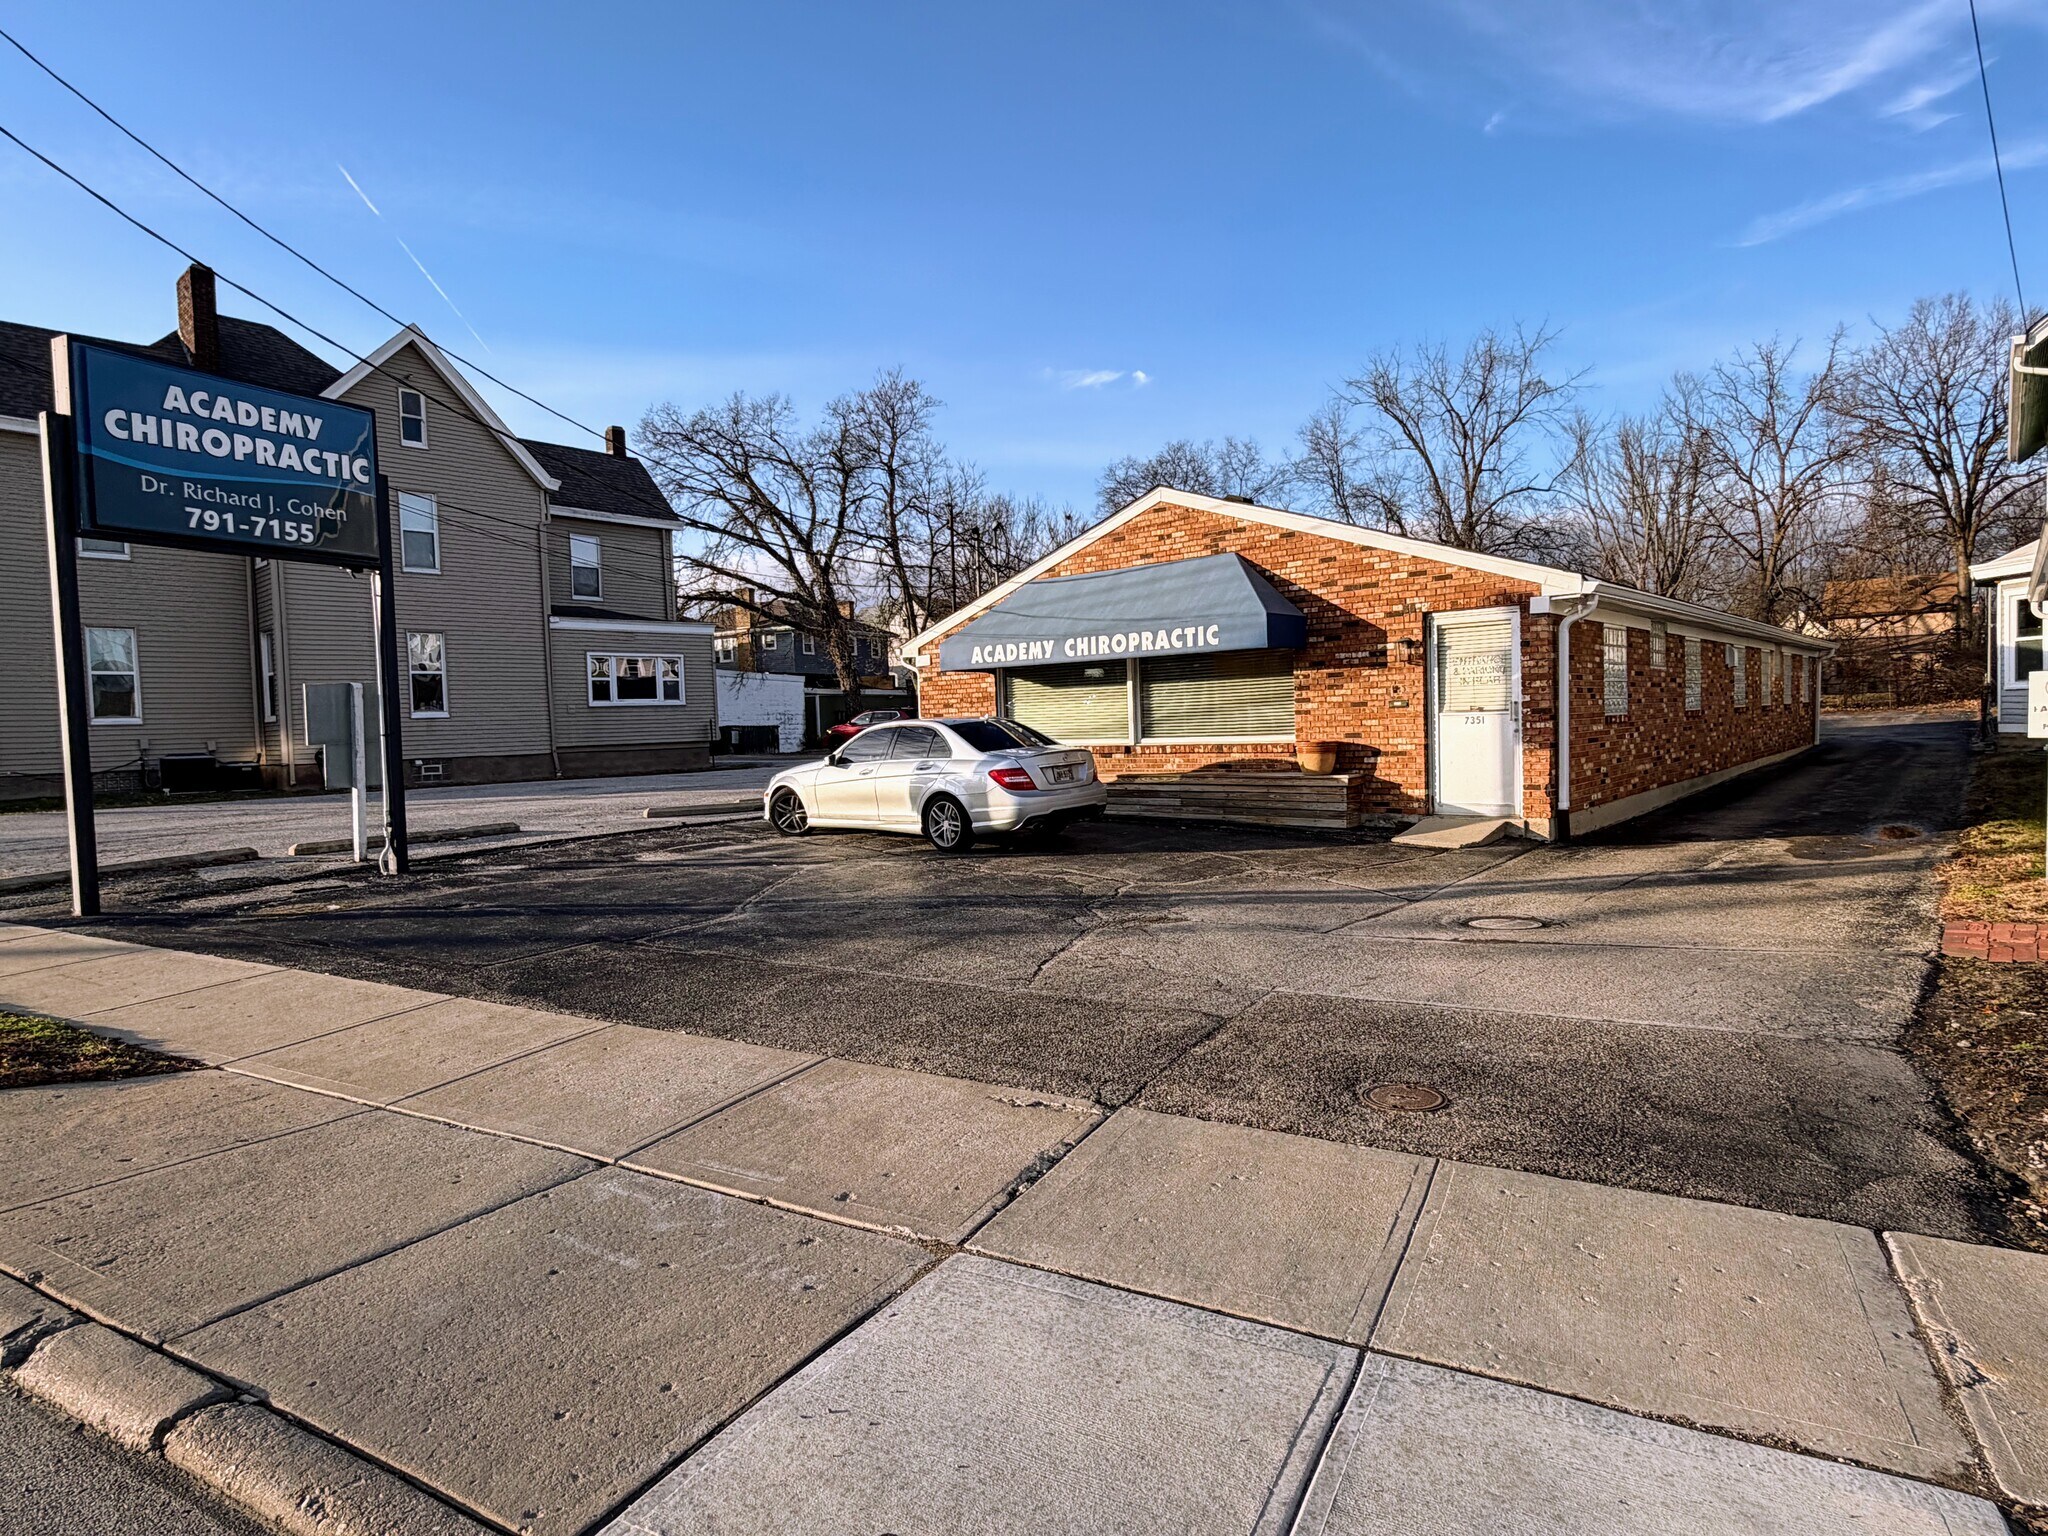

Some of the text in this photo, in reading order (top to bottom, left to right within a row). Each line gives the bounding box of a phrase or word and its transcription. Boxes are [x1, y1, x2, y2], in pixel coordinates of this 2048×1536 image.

[163, 385, 323, 441] ACADEMY
[104, 409, 370, 484] CHIROPRACTIC
[141, 475, 347, 521] Dr. Richard J. Cohen
[185, 507, 315, 544] 791-7155
[971, 624, 1219, 664] ACADEMY CHIROPRACTIC
[1465, 716, 1485, 724] 7351
